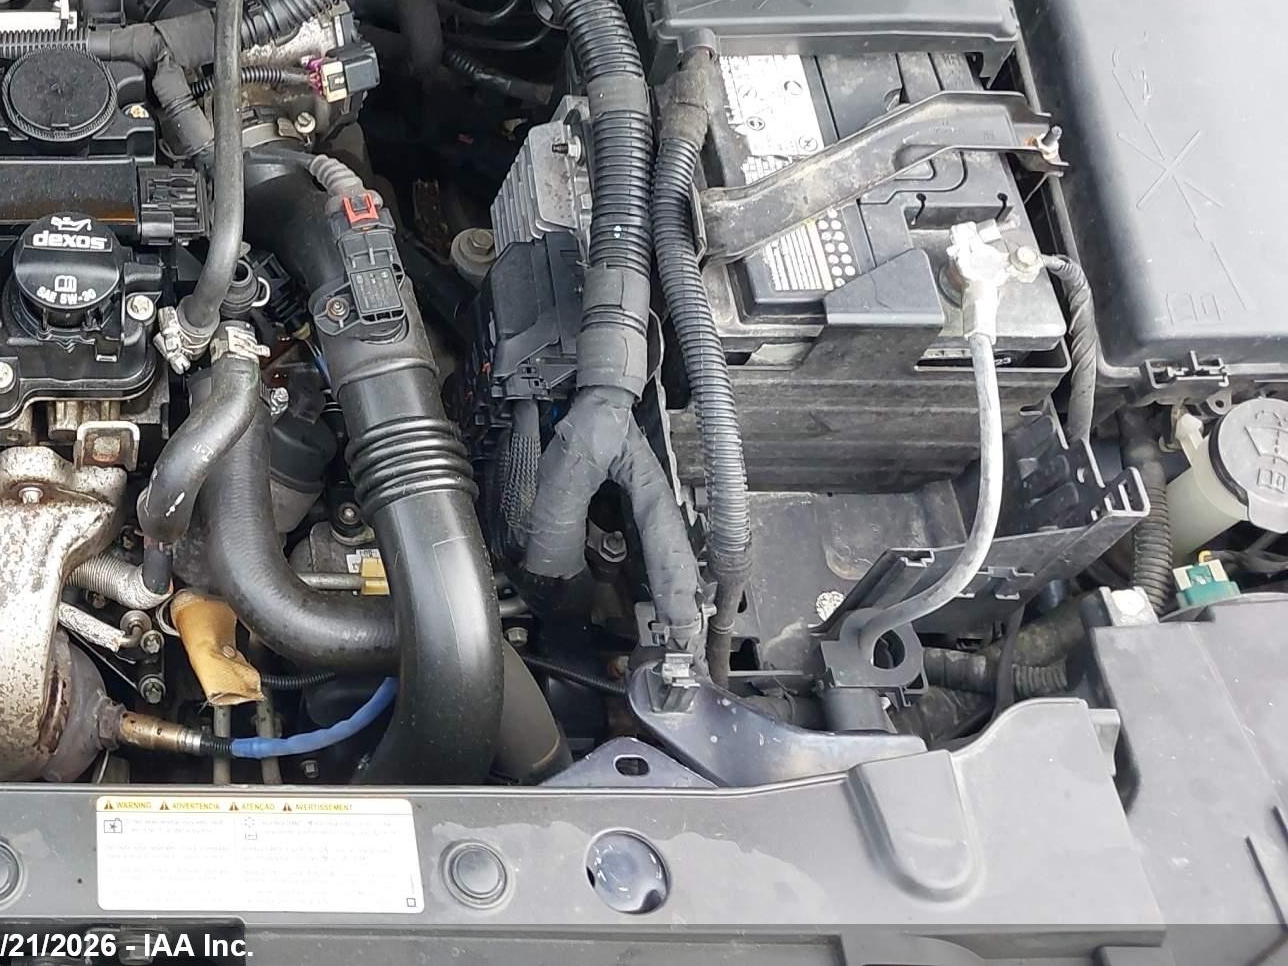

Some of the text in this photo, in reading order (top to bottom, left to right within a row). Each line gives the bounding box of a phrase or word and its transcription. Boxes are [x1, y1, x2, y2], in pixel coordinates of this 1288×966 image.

[32, 230, 107, 250] dexos
[36, 286, 97, 305] SAE 5W-30
[115, 801, 152, 809] WARNING
[295, 803, 353, 811] AVERTISSEMENT
